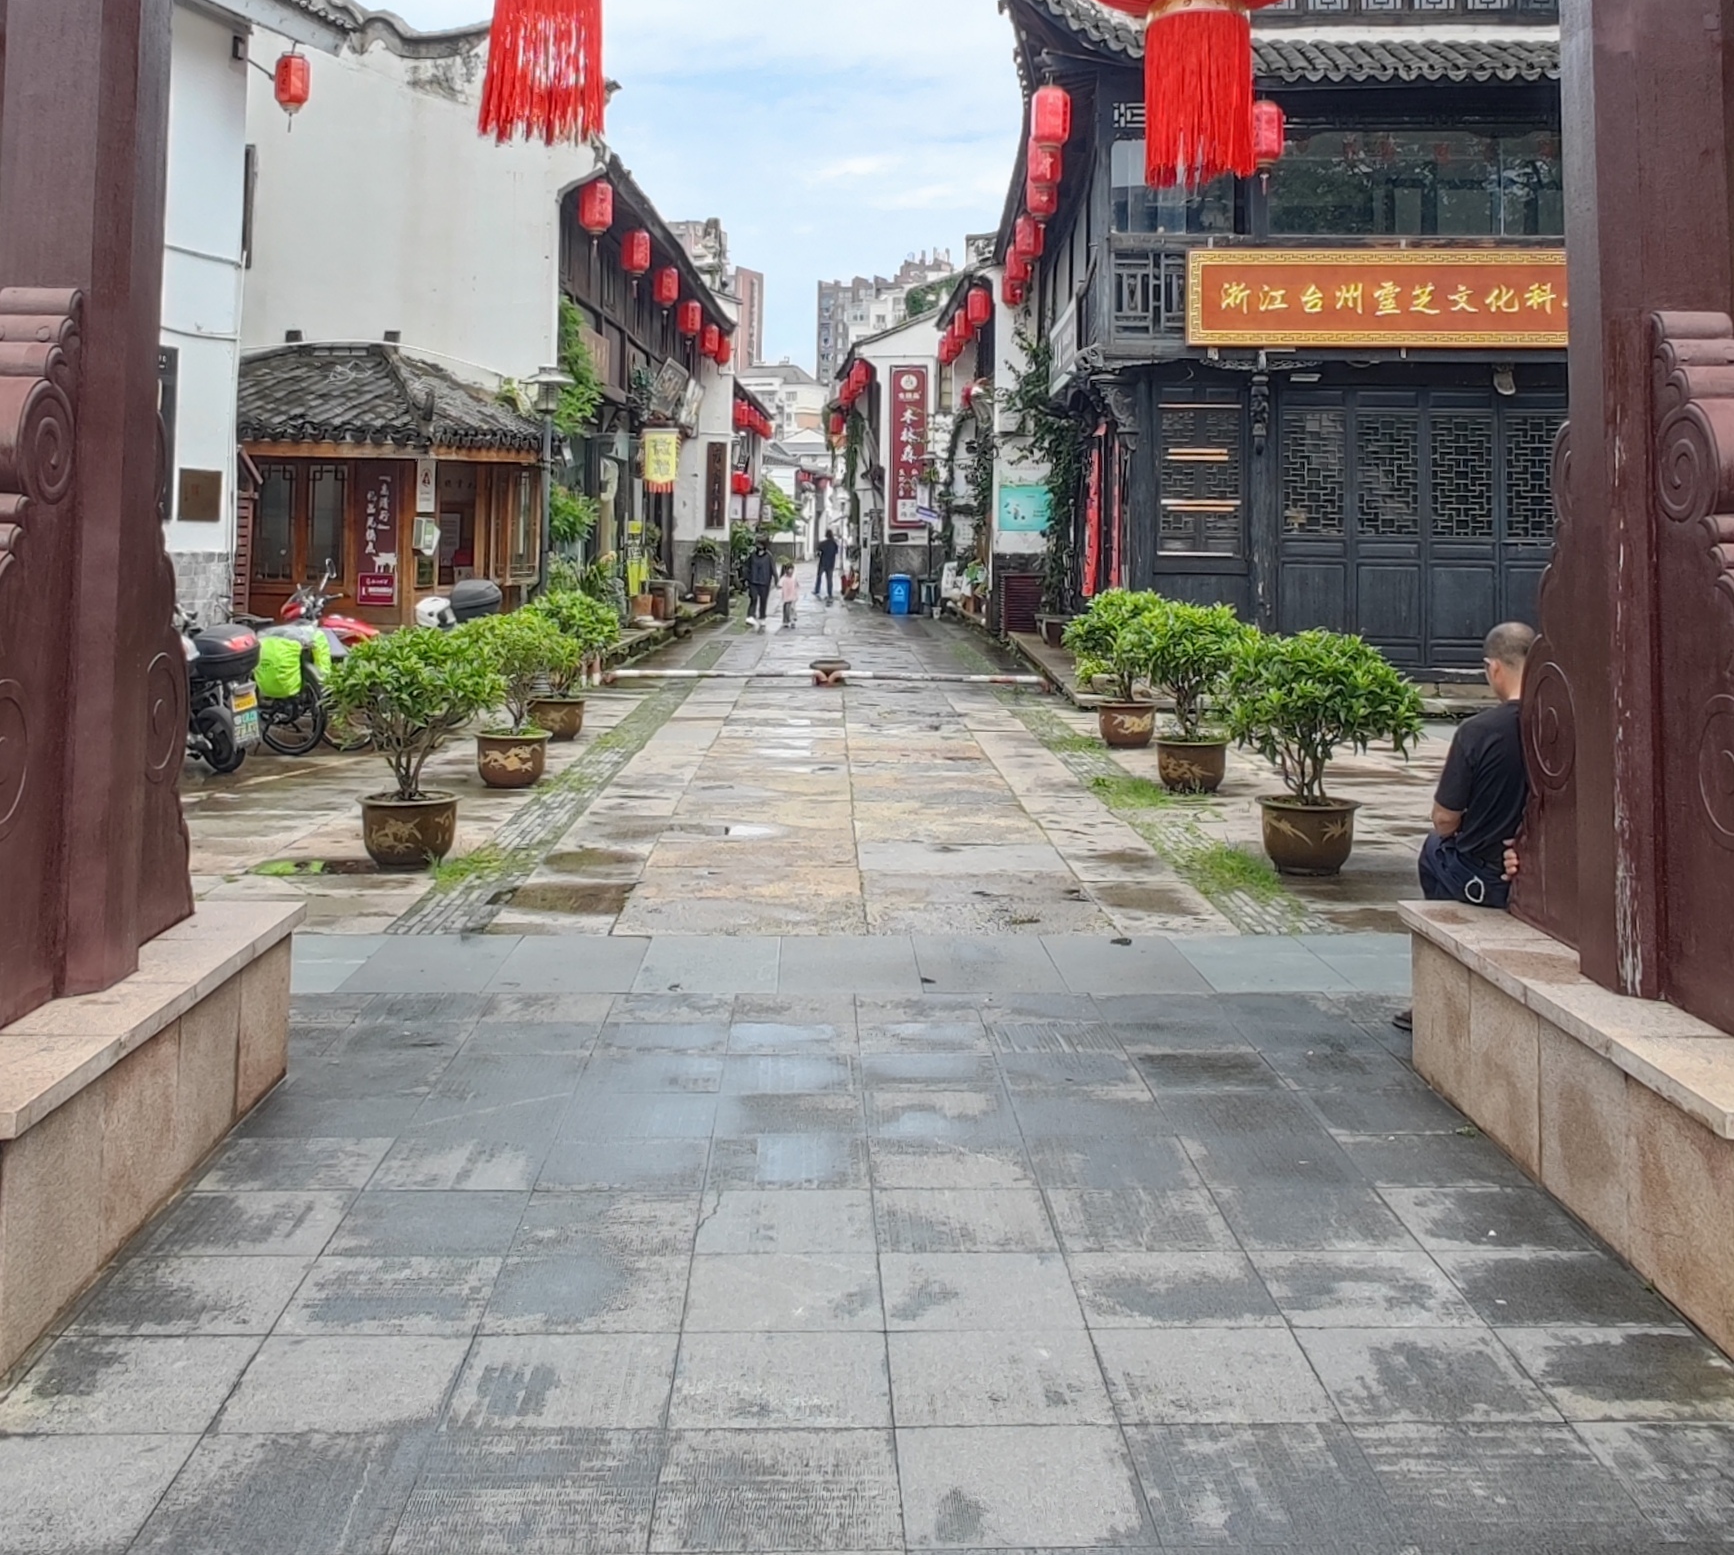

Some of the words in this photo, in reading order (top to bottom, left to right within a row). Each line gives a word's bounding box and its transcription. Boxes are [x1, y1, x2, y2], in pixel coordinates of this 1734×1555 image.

[1220, 280, 1568, 317] 浙江台州靈芝文化科
